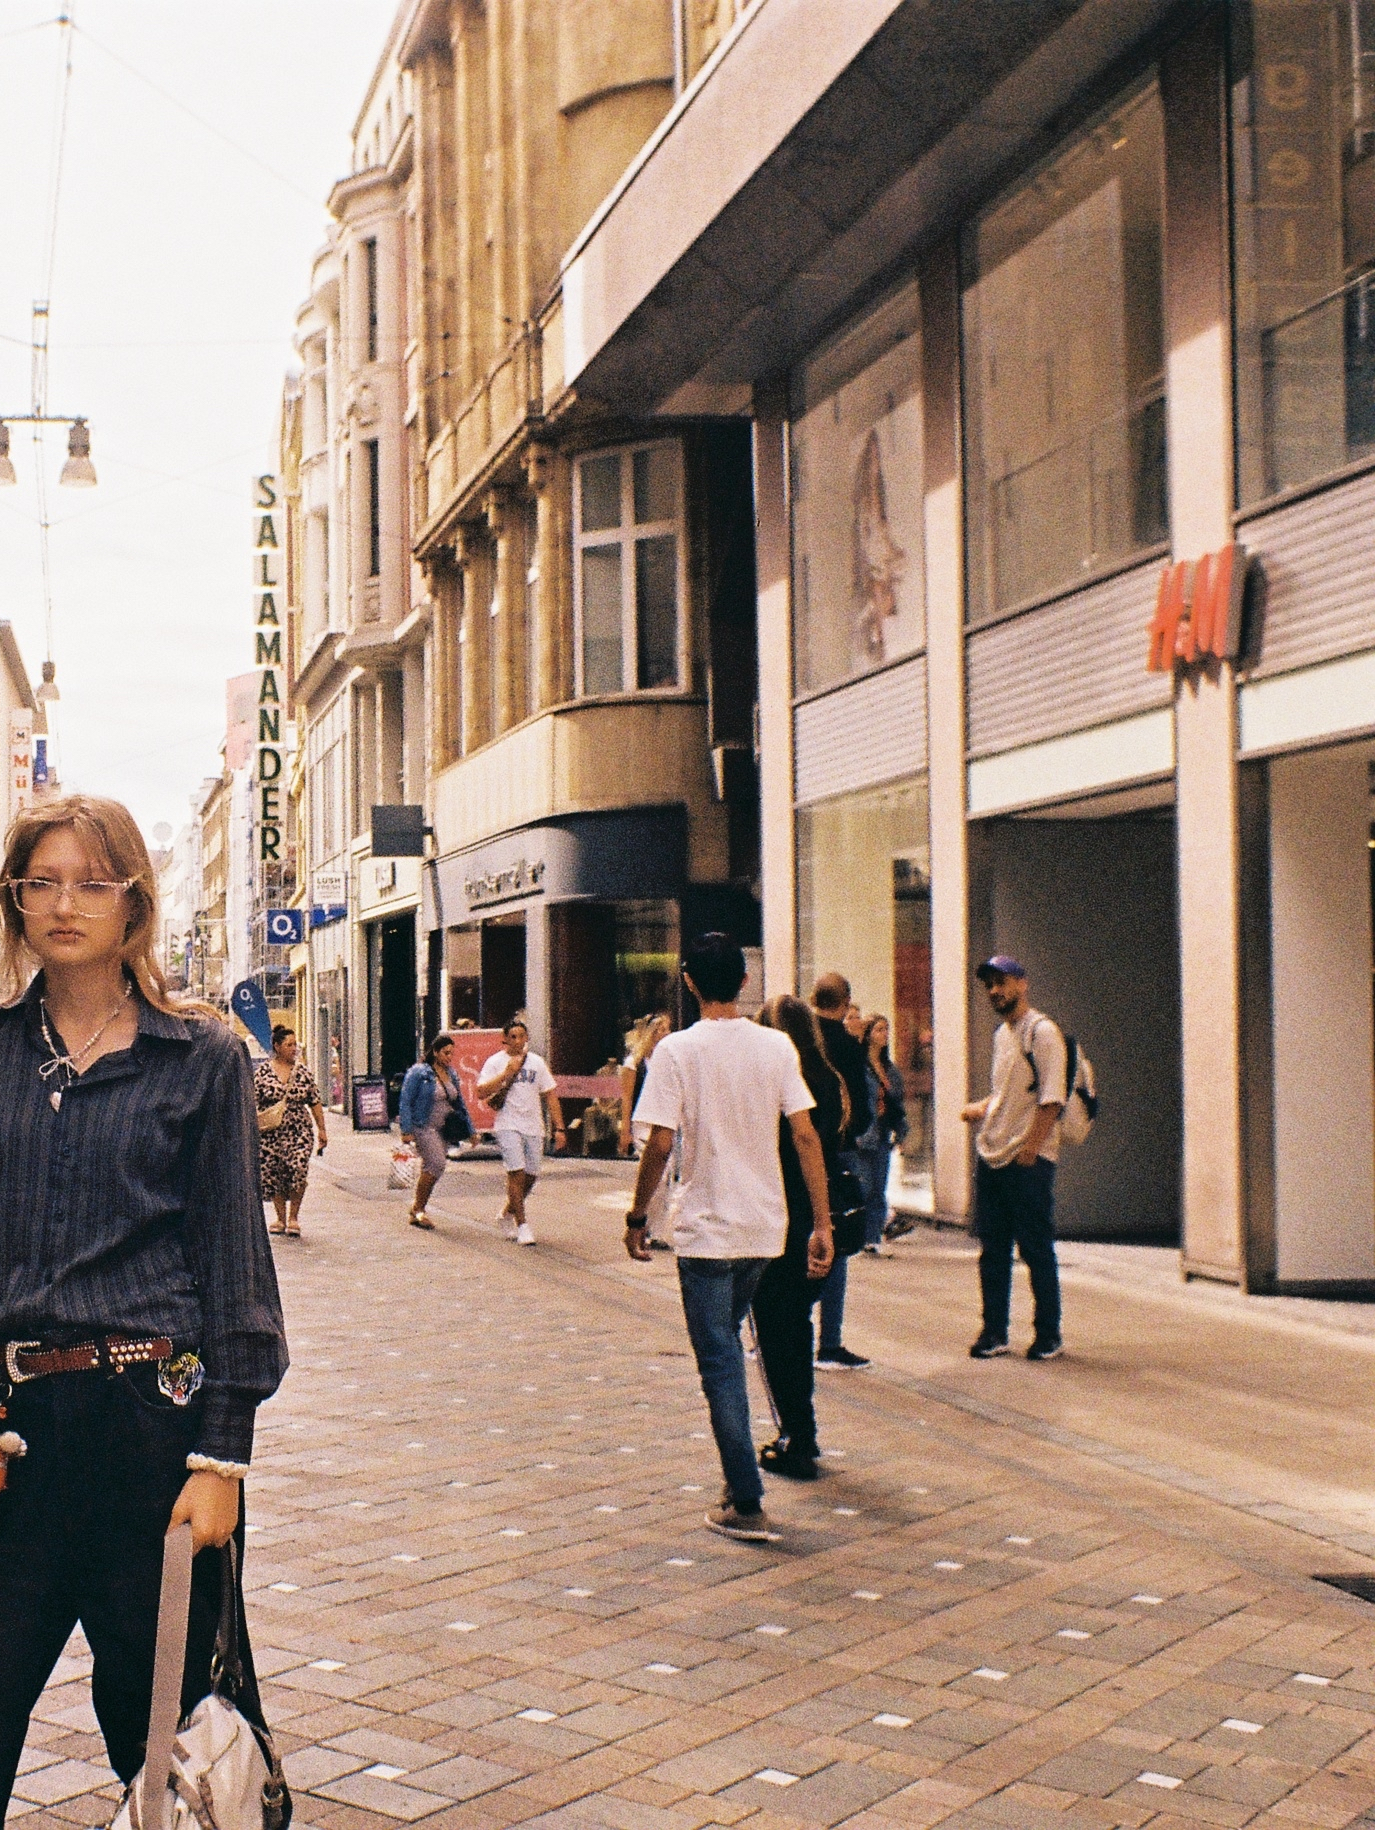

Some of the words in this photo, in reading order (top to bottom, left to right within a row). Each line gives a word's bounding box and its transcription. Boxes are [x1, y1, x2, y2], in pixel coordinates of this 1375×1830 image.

[256, 475, 281, 860] SALAMANDER
[1146, 543, 1235, 673] H&M
[316, 876, 341, 885] LUSH
